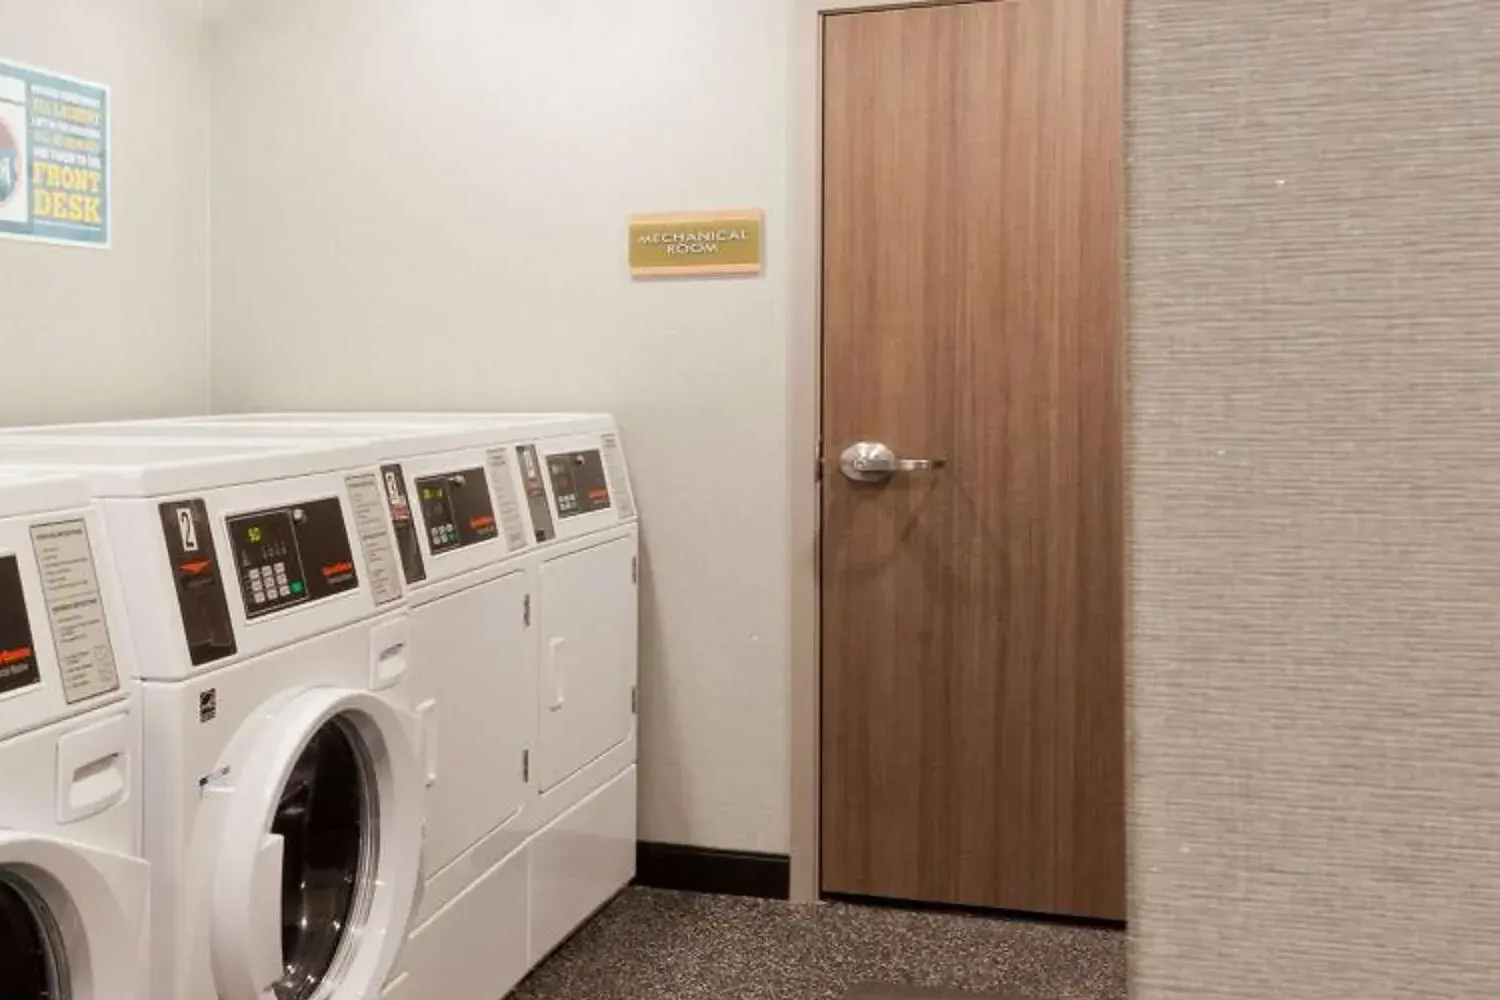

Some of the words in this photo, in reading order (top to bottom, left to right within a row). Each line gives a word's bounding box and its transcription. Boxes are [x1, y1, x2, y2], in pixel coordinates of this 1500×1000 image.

[33, 161, 101, 192] FRONT
[33, 188, 101, 223] DESK
[638, 229, 749, 245] MECHANICAL
[666, 243, 718, 256] ROOM
